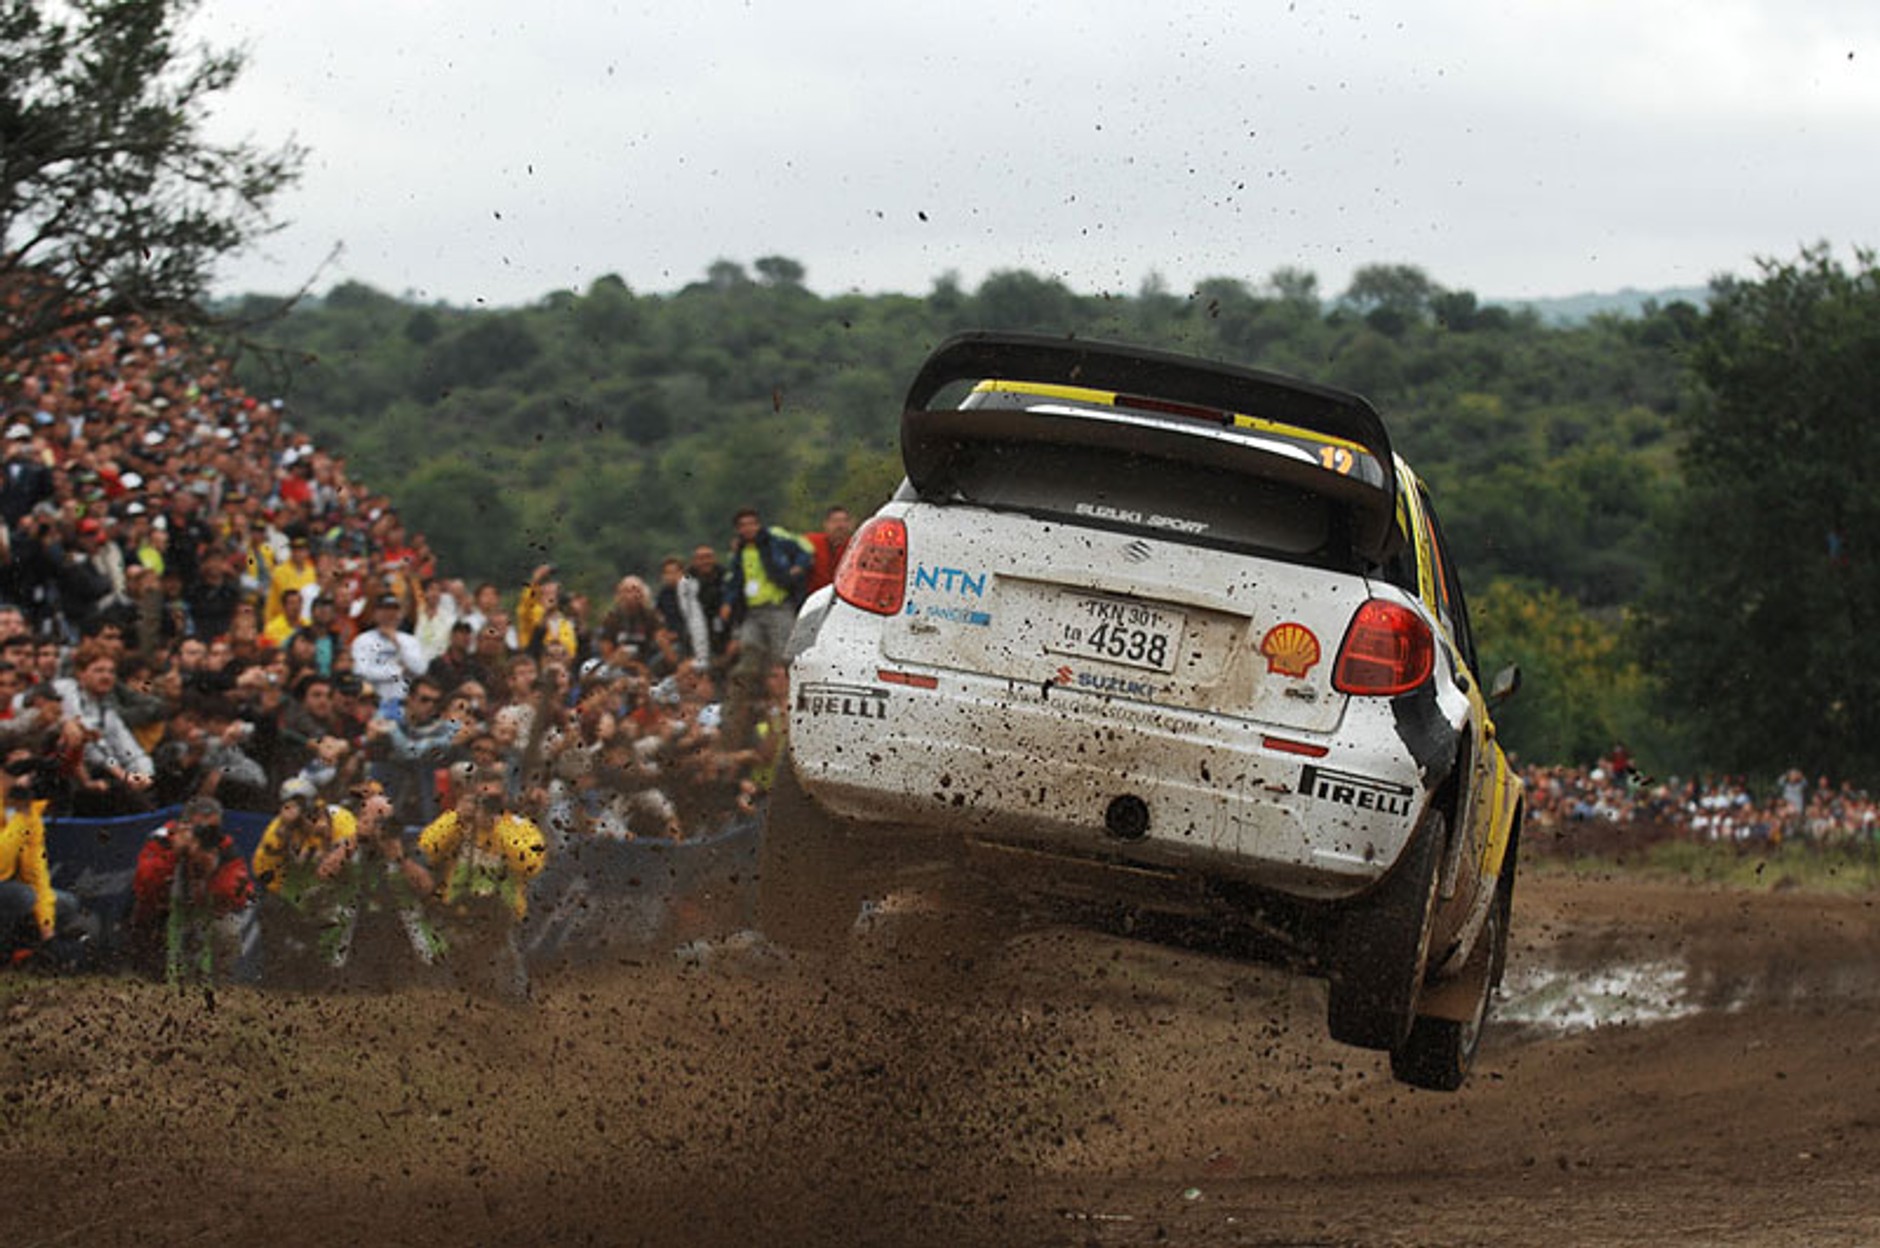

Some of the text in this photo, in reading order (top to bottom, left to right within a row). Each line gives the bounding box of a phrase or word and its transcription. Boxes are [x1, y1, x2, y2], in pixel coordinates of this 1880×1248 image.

[1074, 502, 1209, 534] SUZUKI SPORT
[914, 565, 986, 599] NTN
[1128, 608, 1158, 628] 301
[1088, 623, 1168, 667] 4538
[1078, 672, 1154, 697] SUZUKI
[1298, 764, 1413, 817] PIRELLI
